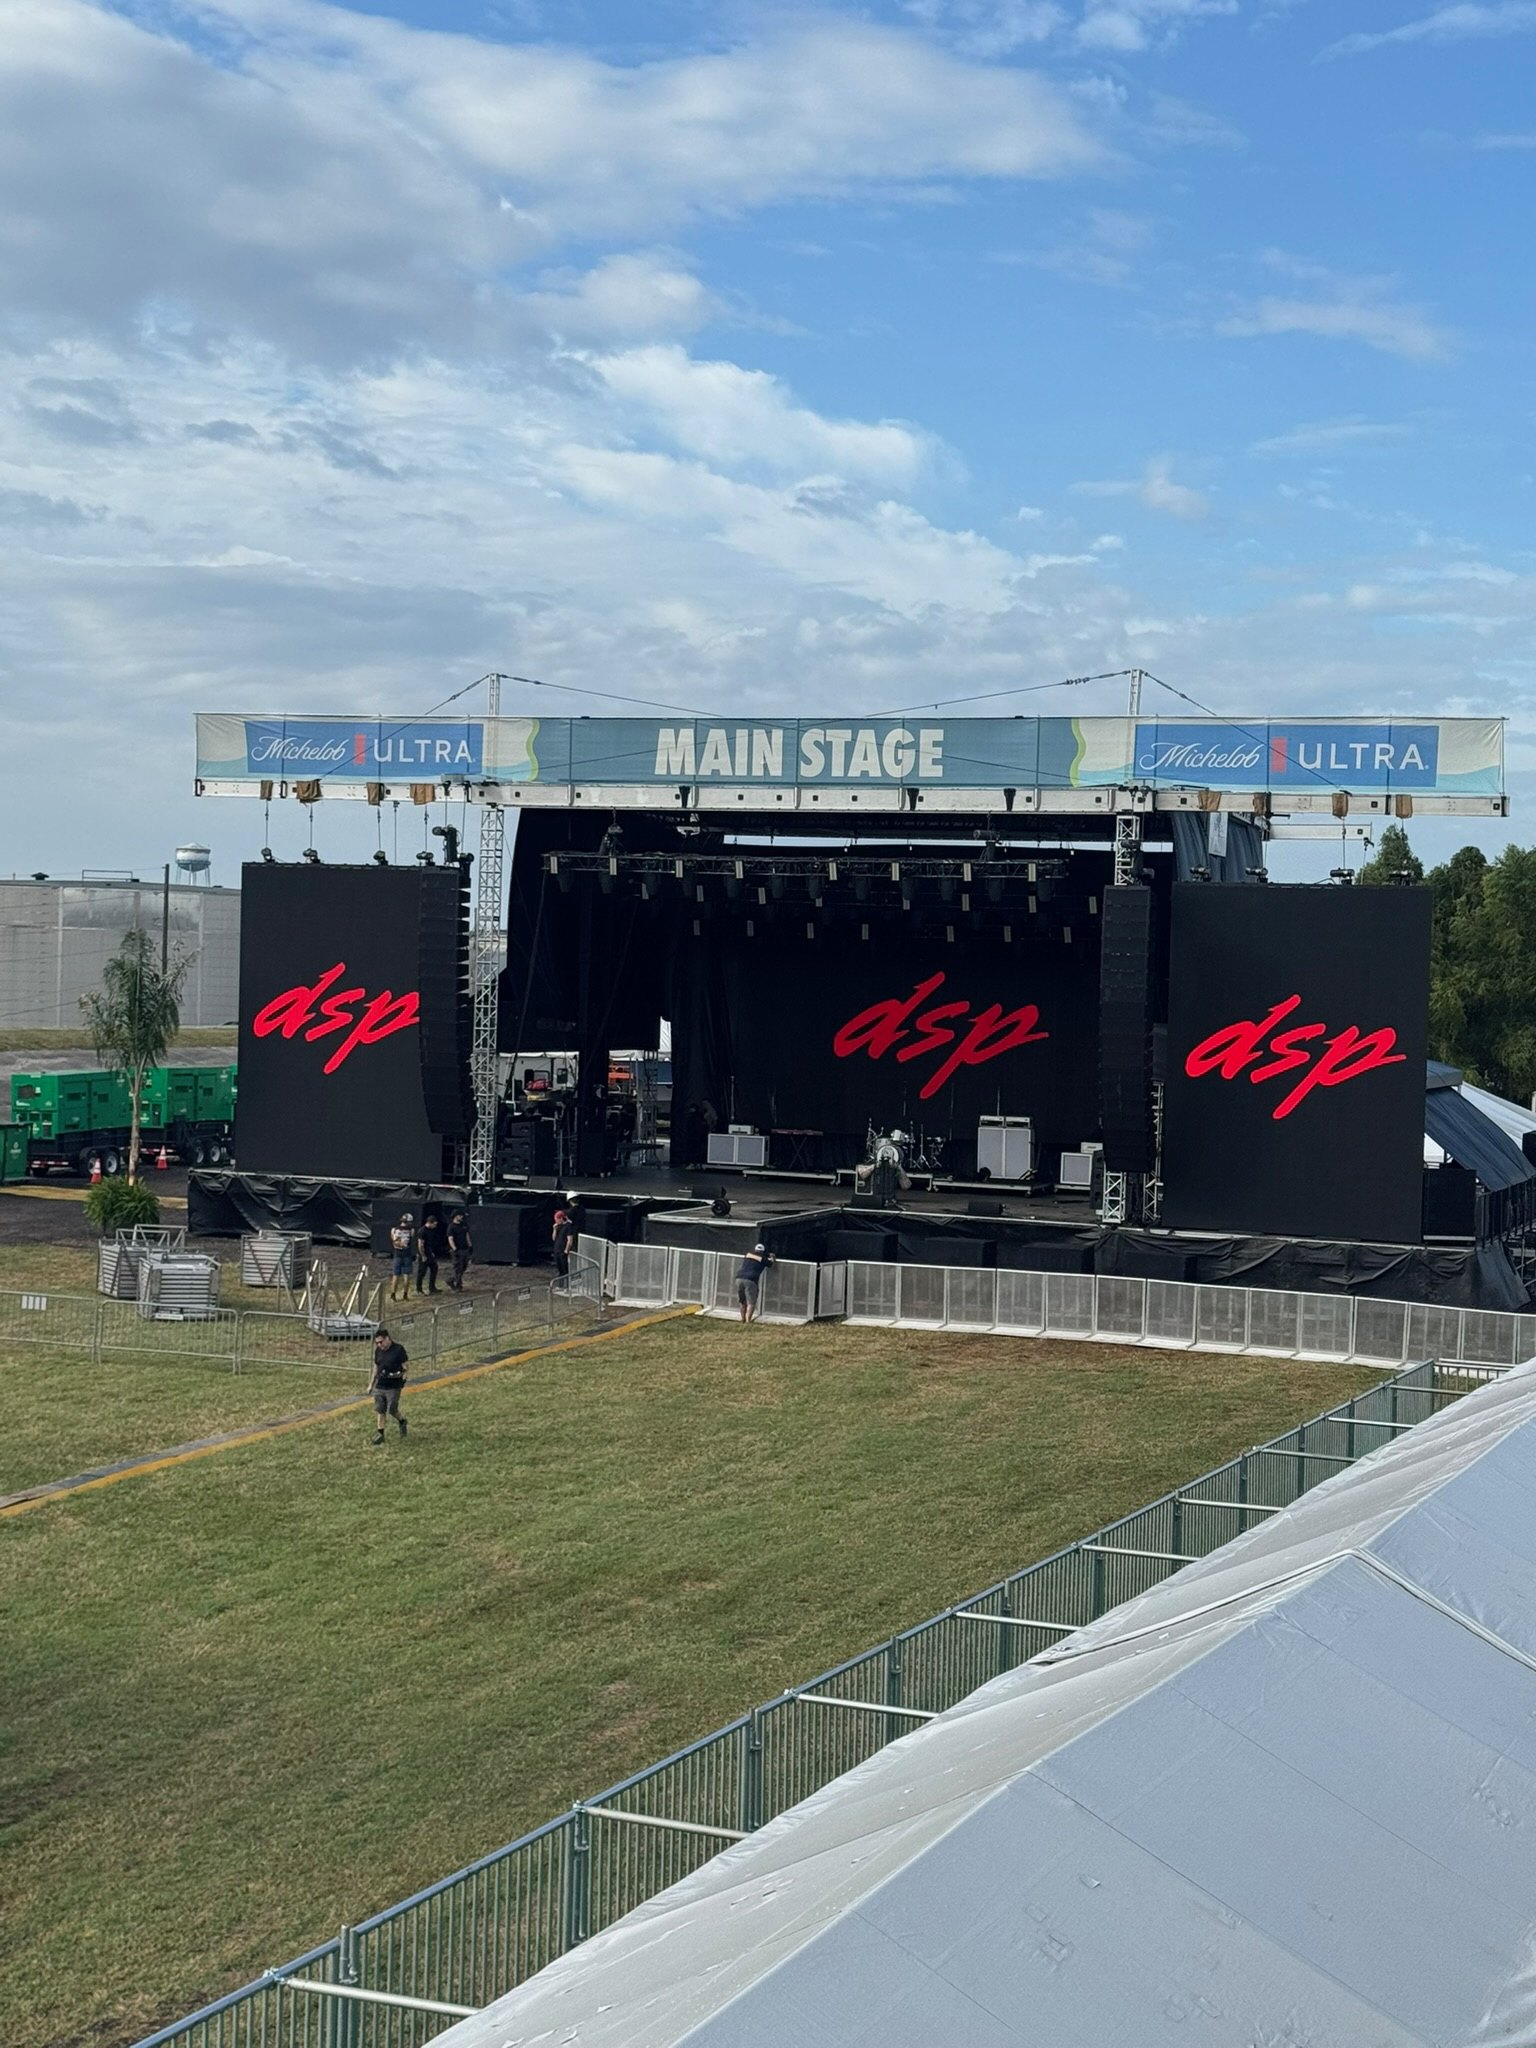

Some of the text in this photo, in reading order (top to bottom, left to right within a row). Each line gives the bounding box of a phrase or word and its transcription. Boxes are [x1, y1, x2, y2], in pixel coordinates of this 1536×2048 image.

[251, 736, 473, 763] Michelob ULTRA
[654, 728, 944, 777] MAIN STAGE
[1139, 742, 1425, 770] Michelob ULTRA
[252, 963, 420, 1075] dsp
[834, 971, 1049, 1099] dsp
[1185, 994, 1407, 1120] dsp
